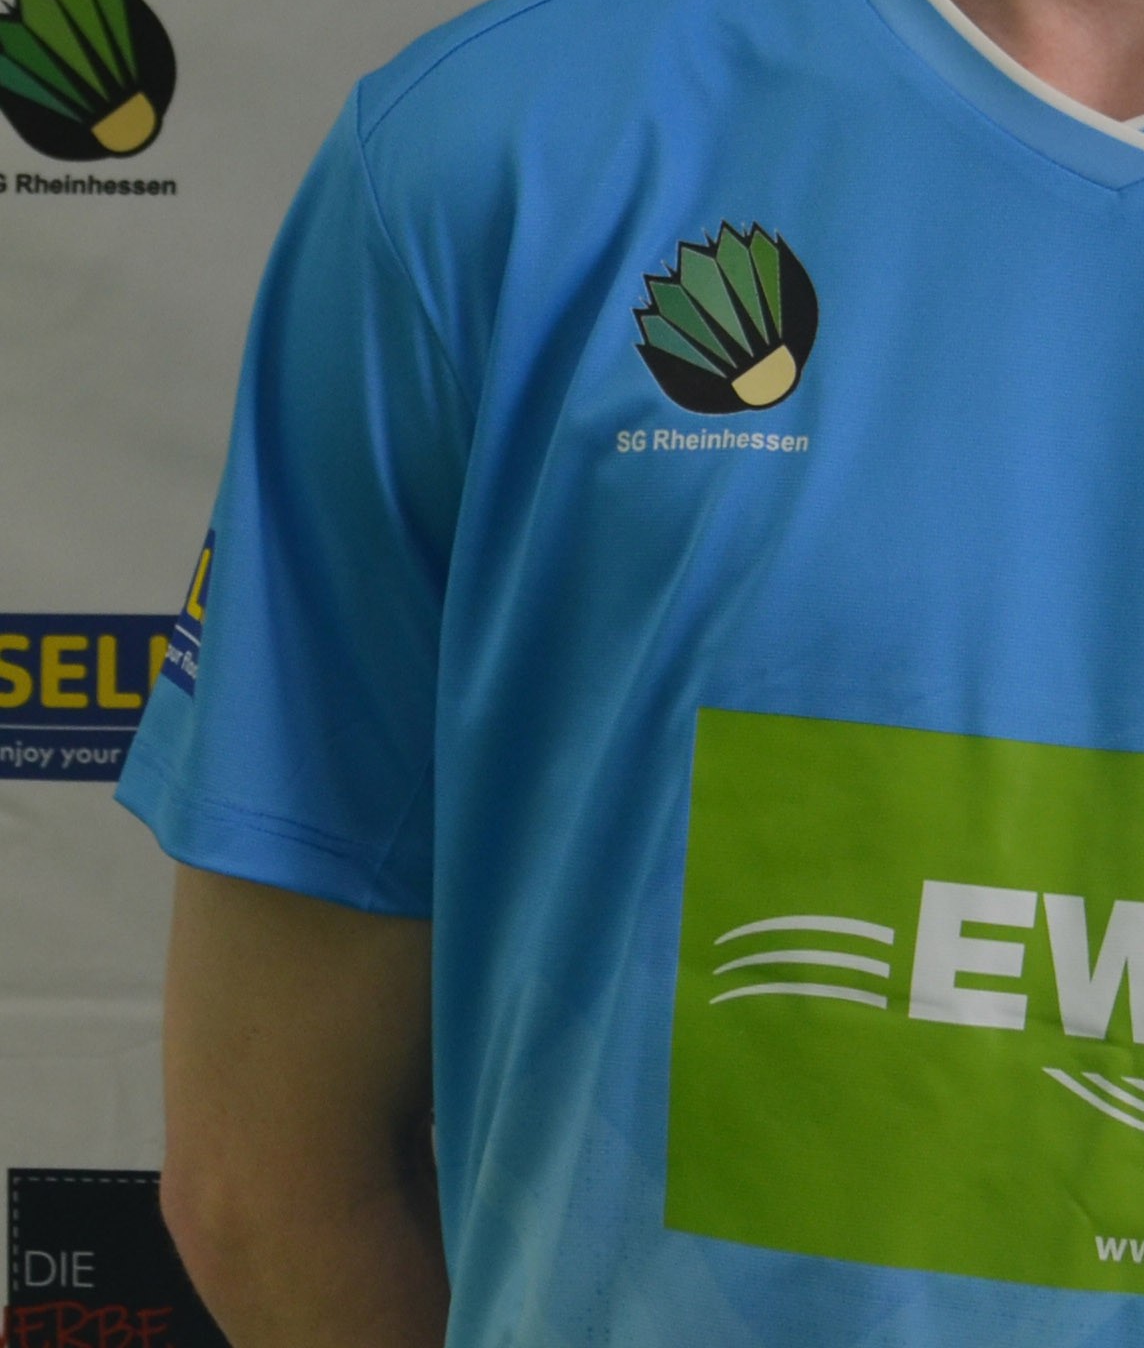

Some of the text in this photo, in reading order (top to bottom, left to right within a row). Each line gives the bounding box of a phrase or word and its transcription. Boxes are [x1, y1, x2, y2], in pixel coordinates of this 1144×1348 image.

[16, 173, 177, 195] Rheinhessen
[616, 428, 809, 453] SG Rheinhessen
[0, 633, 169, 708] SELI
[0, 742, 121, 769] njoy your
[24, 1250, 95, 1288] DIE
[0, 1300, 174, 1348] ERBE
